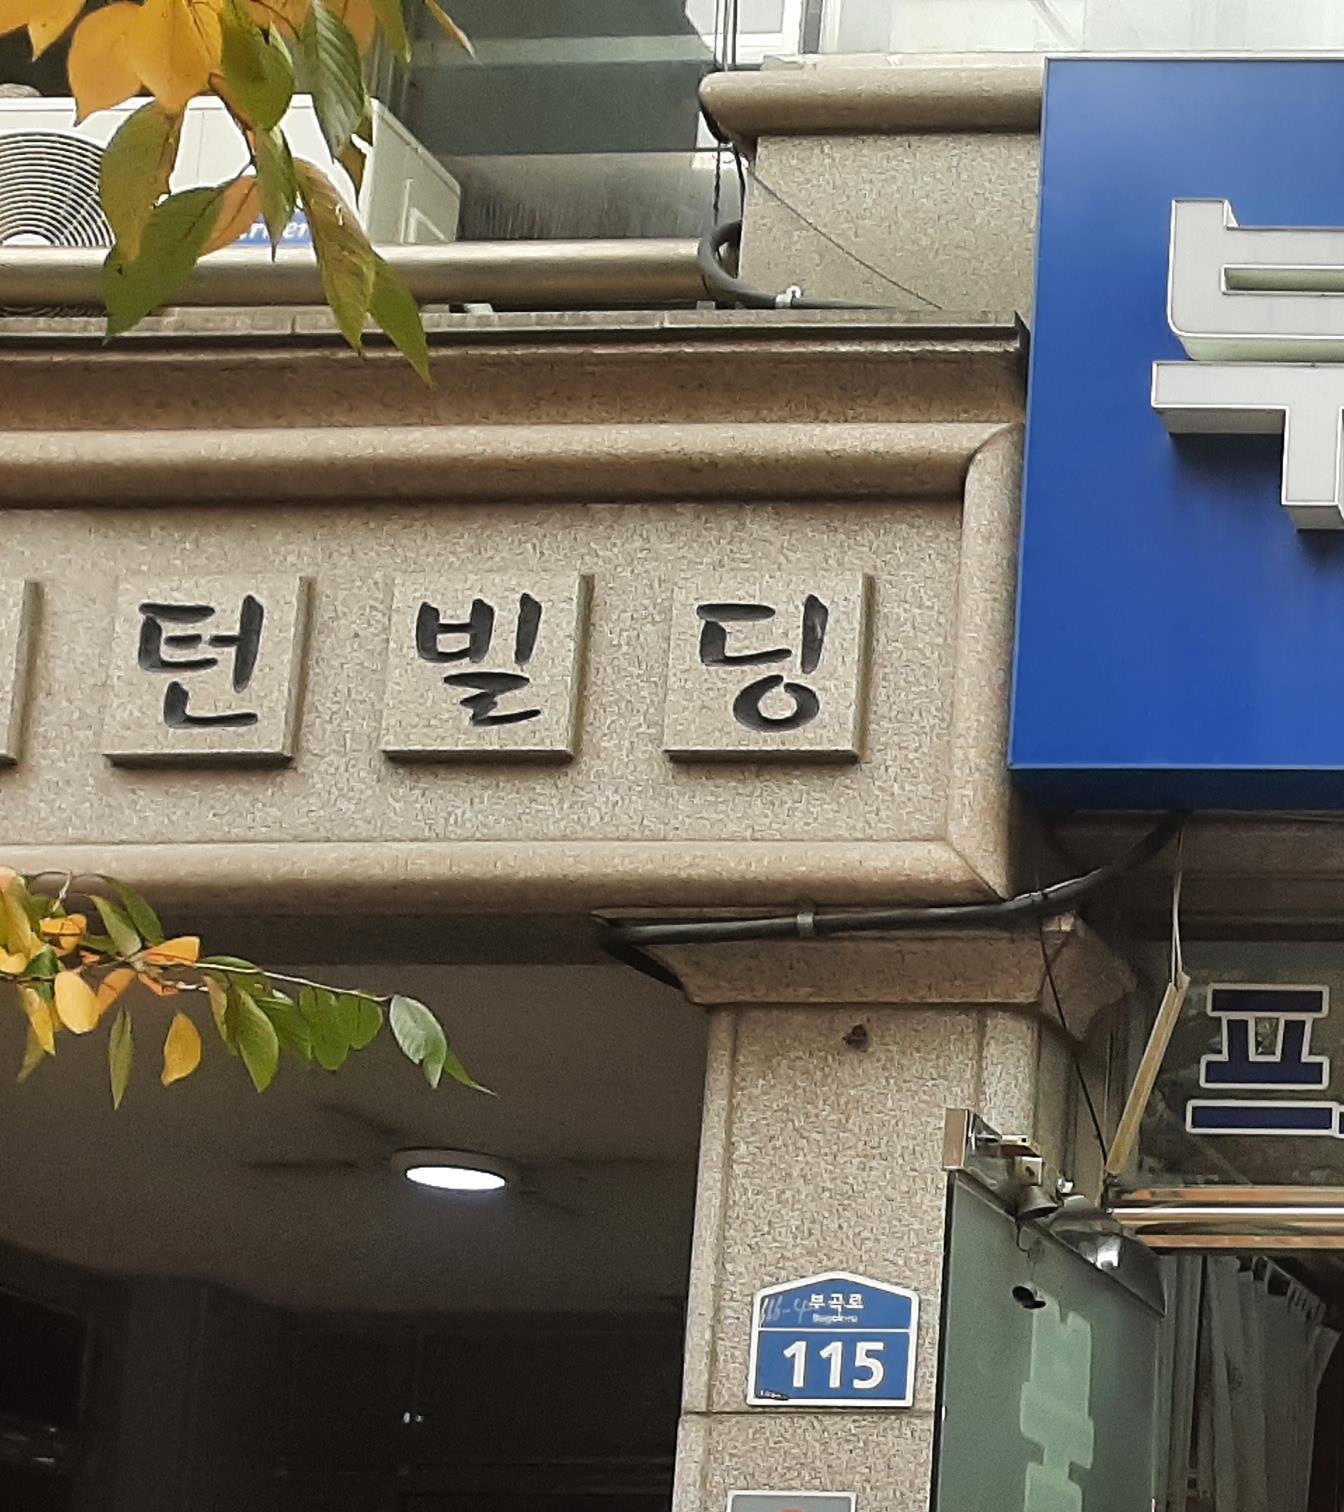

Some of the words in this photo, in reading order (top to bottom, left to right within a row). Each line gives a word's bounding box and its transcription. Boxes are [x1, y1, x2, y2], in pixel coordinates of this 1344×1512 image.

[137, 592, 830, 735] 턴빌딩
[808, 1293, 865, 1313] 부곡로
[783, 1340, 885, 1390] 115
